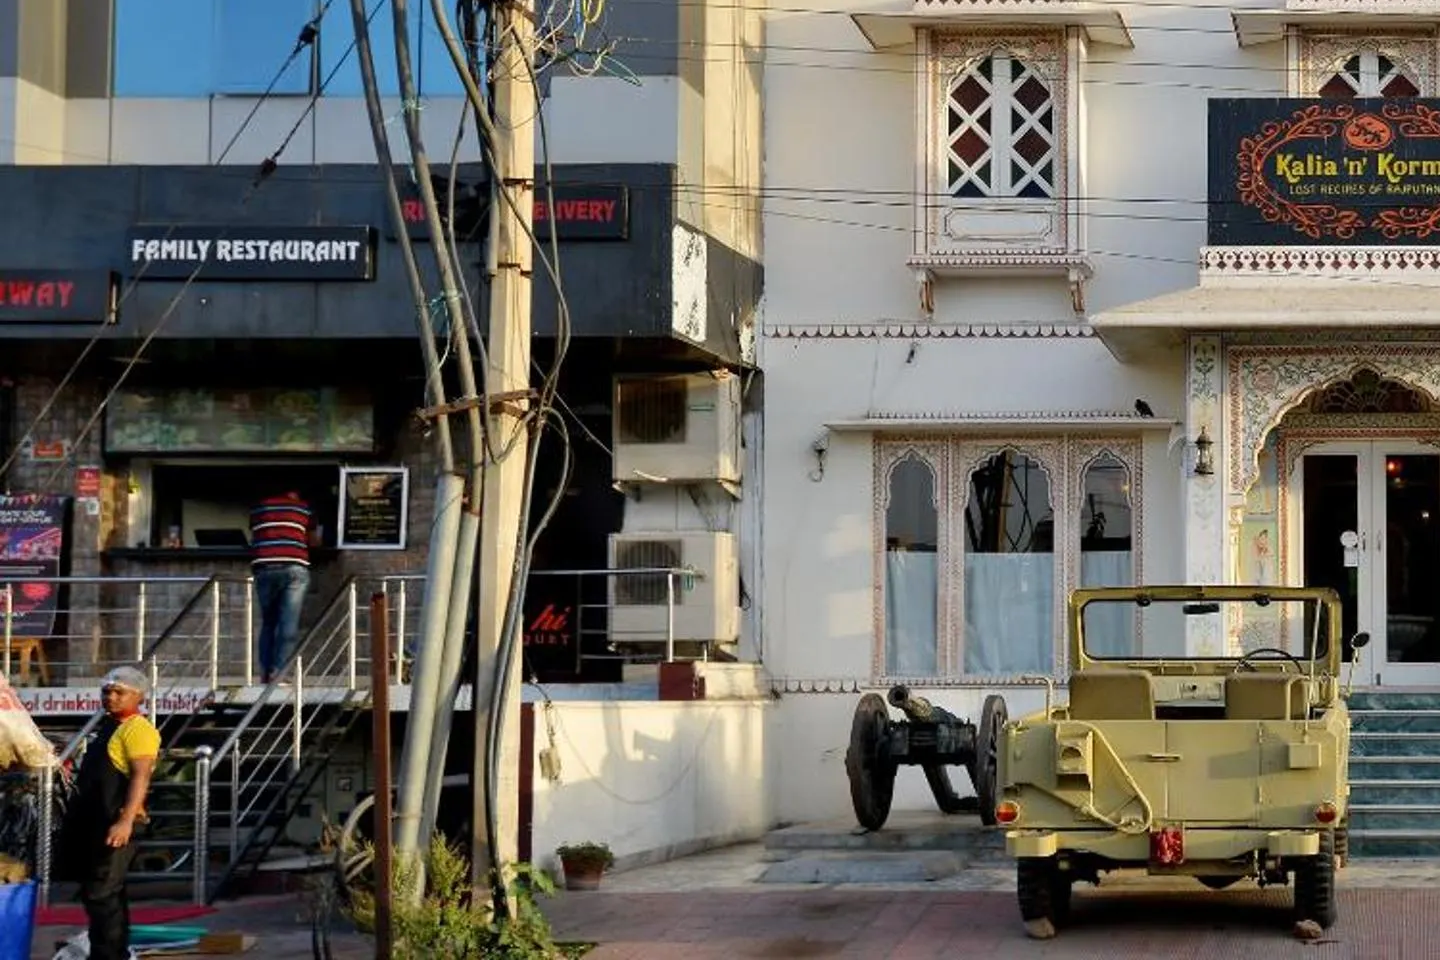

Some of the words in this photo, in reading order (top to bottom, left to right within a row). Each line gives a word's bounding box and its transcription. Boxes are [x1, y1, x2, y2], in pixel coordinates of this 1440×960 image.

[1276, 153, 1338, 183] Kalia
[1289, 183, 1315, 195] LOST
[1320, 183, 1365, 195] RECIPES
[1368, 183, 1383, 195] OF
[132, 239, 211, 262] FAMILY
[216, 239, 360, 262] RESTAURANT
[43, 693, 101, 712] drinkin
